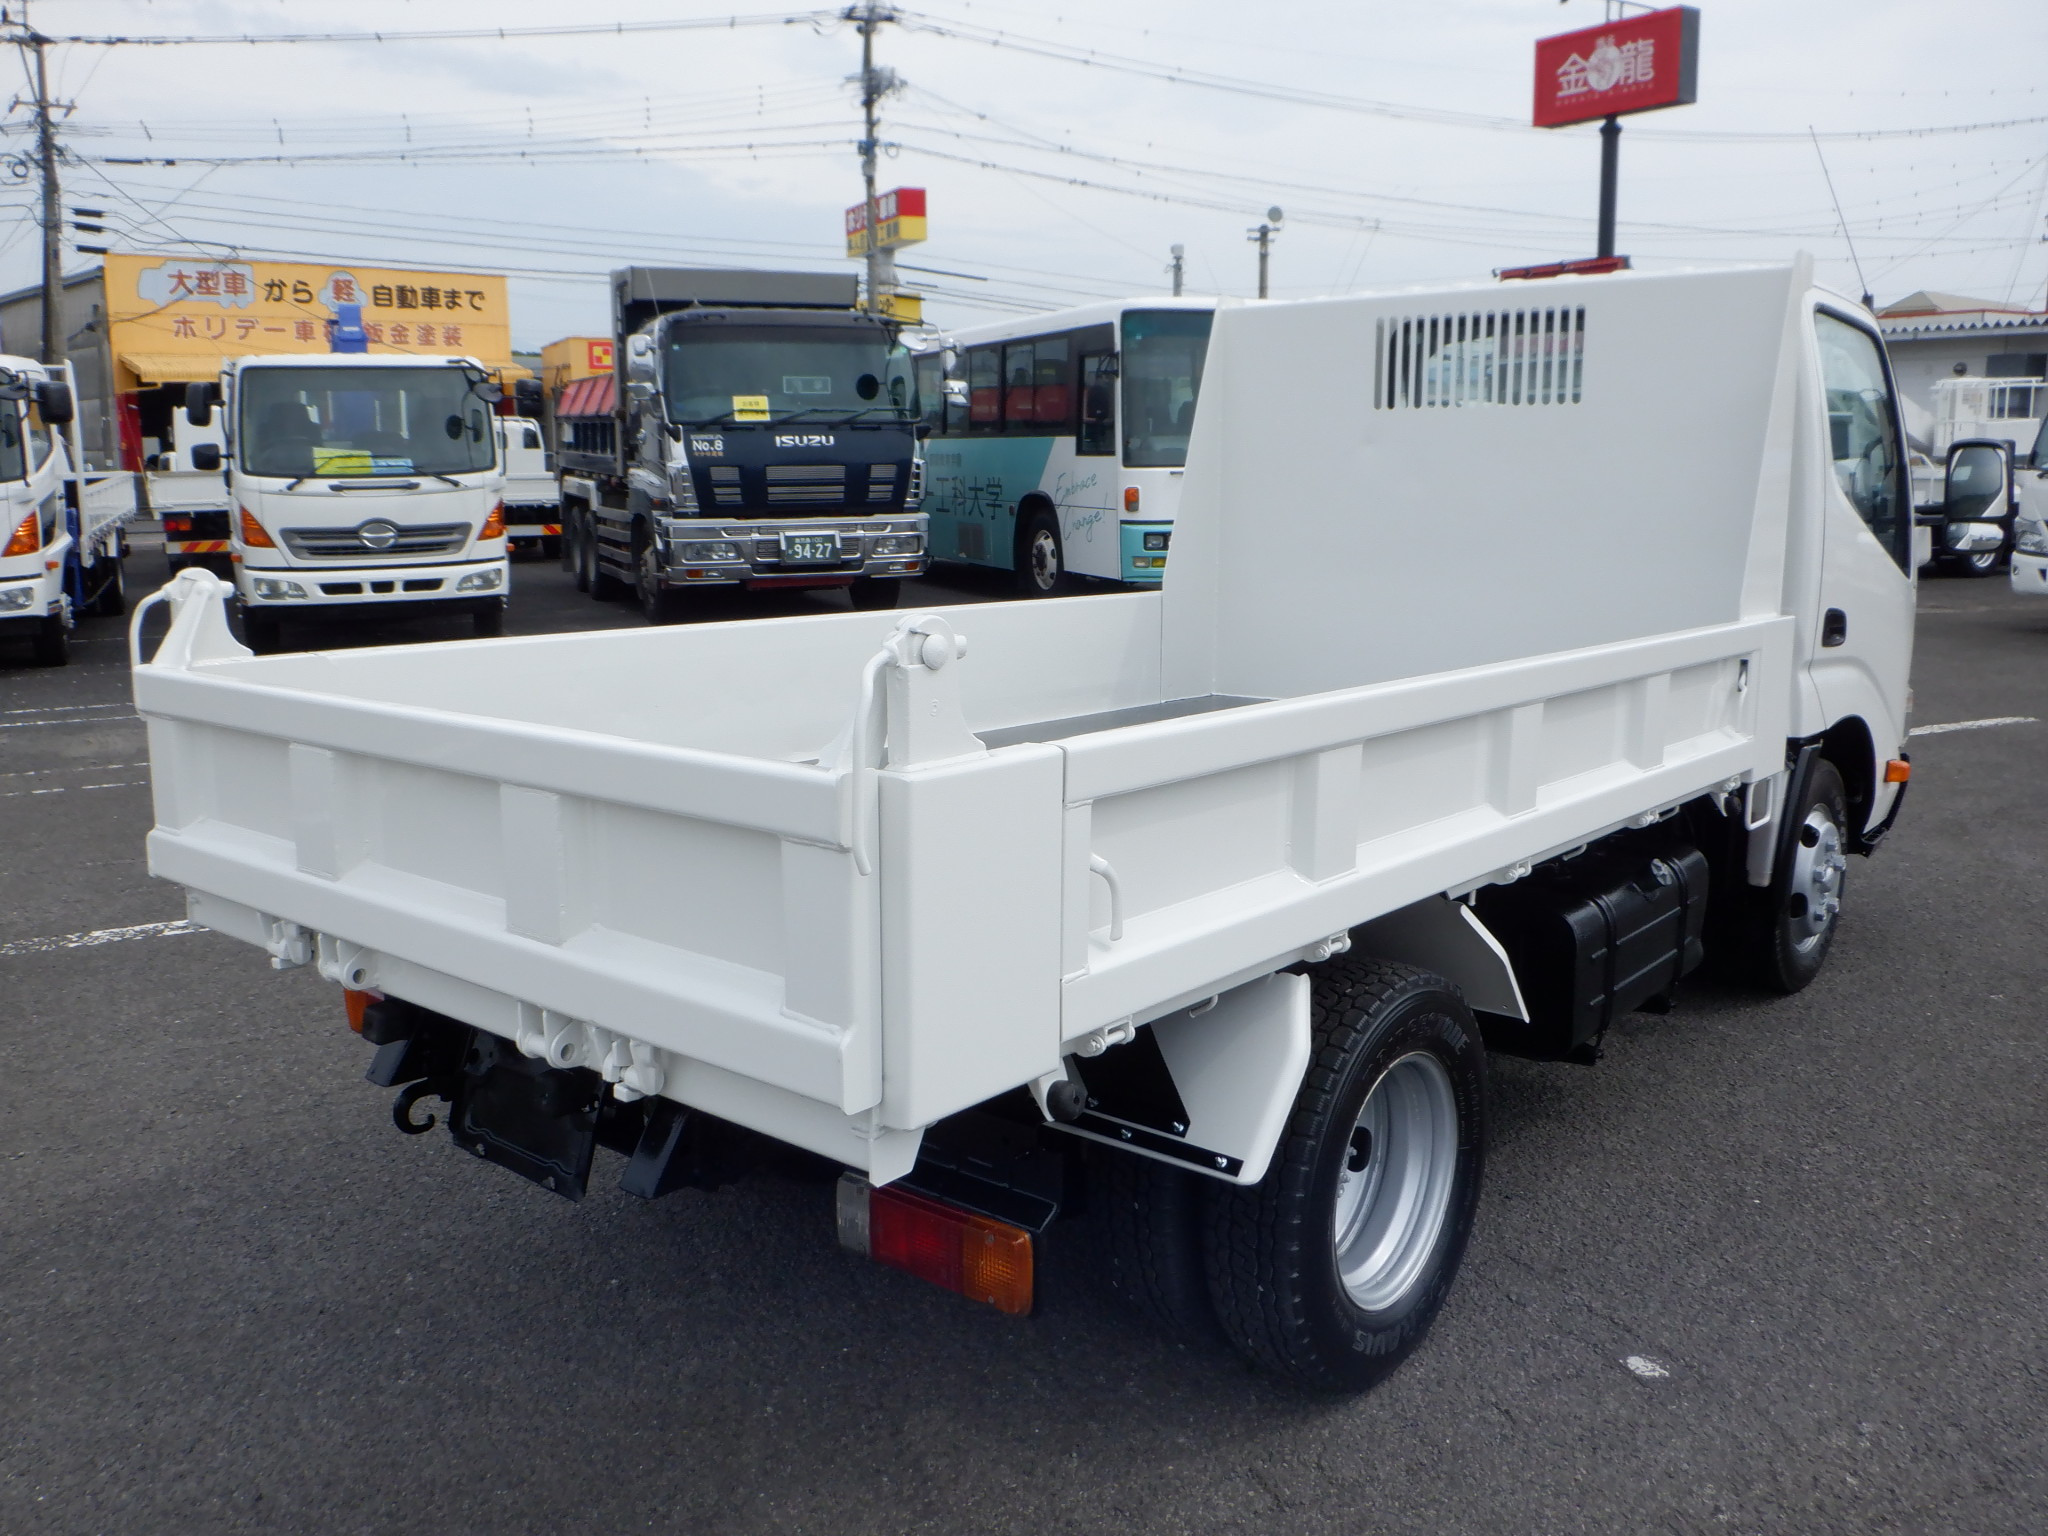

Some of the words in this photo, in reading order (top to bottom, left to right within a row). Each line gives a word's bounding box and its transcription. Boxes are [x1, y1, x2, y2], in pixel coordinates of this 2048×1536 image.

[167, 269, 248, 296] 大型車
[264, 278, 314, 304] から
[331, 277, 356, 302] 軽
[372, 284, 485, 312] 自動車まで
[692, 440, 723, 452] No.8
[775, 435, 835, 447] ISUZU
[1054, 470, 1097, 509] Embrace
[794, 543, 832, 559] 94-27
